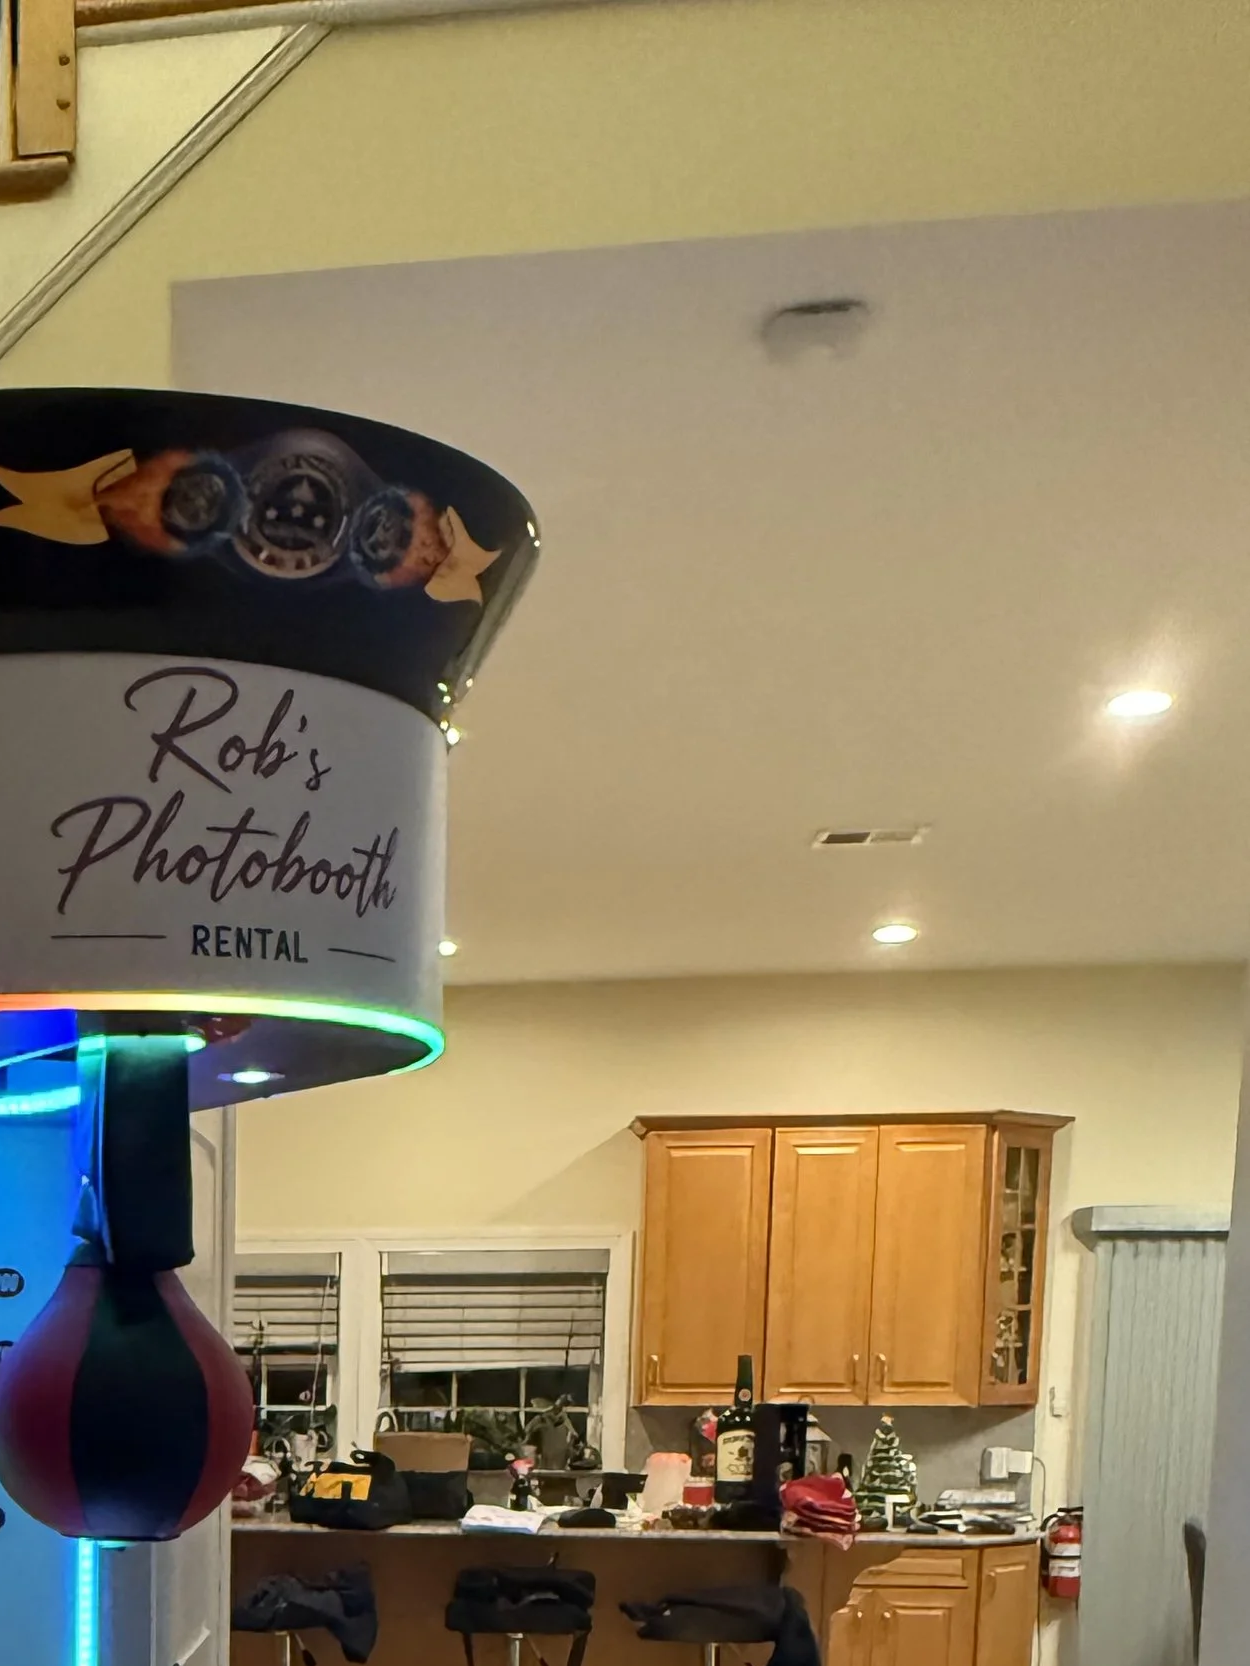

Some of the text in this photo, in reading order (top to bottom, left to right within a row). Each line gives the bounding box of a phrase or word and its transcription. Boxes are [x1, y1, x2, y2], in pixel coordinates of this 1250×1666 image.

[124, 666, 332, 794] Rob's
[50, 789, 399, 917] Photobooth
[191, 924, 309, 963] RENTAL
